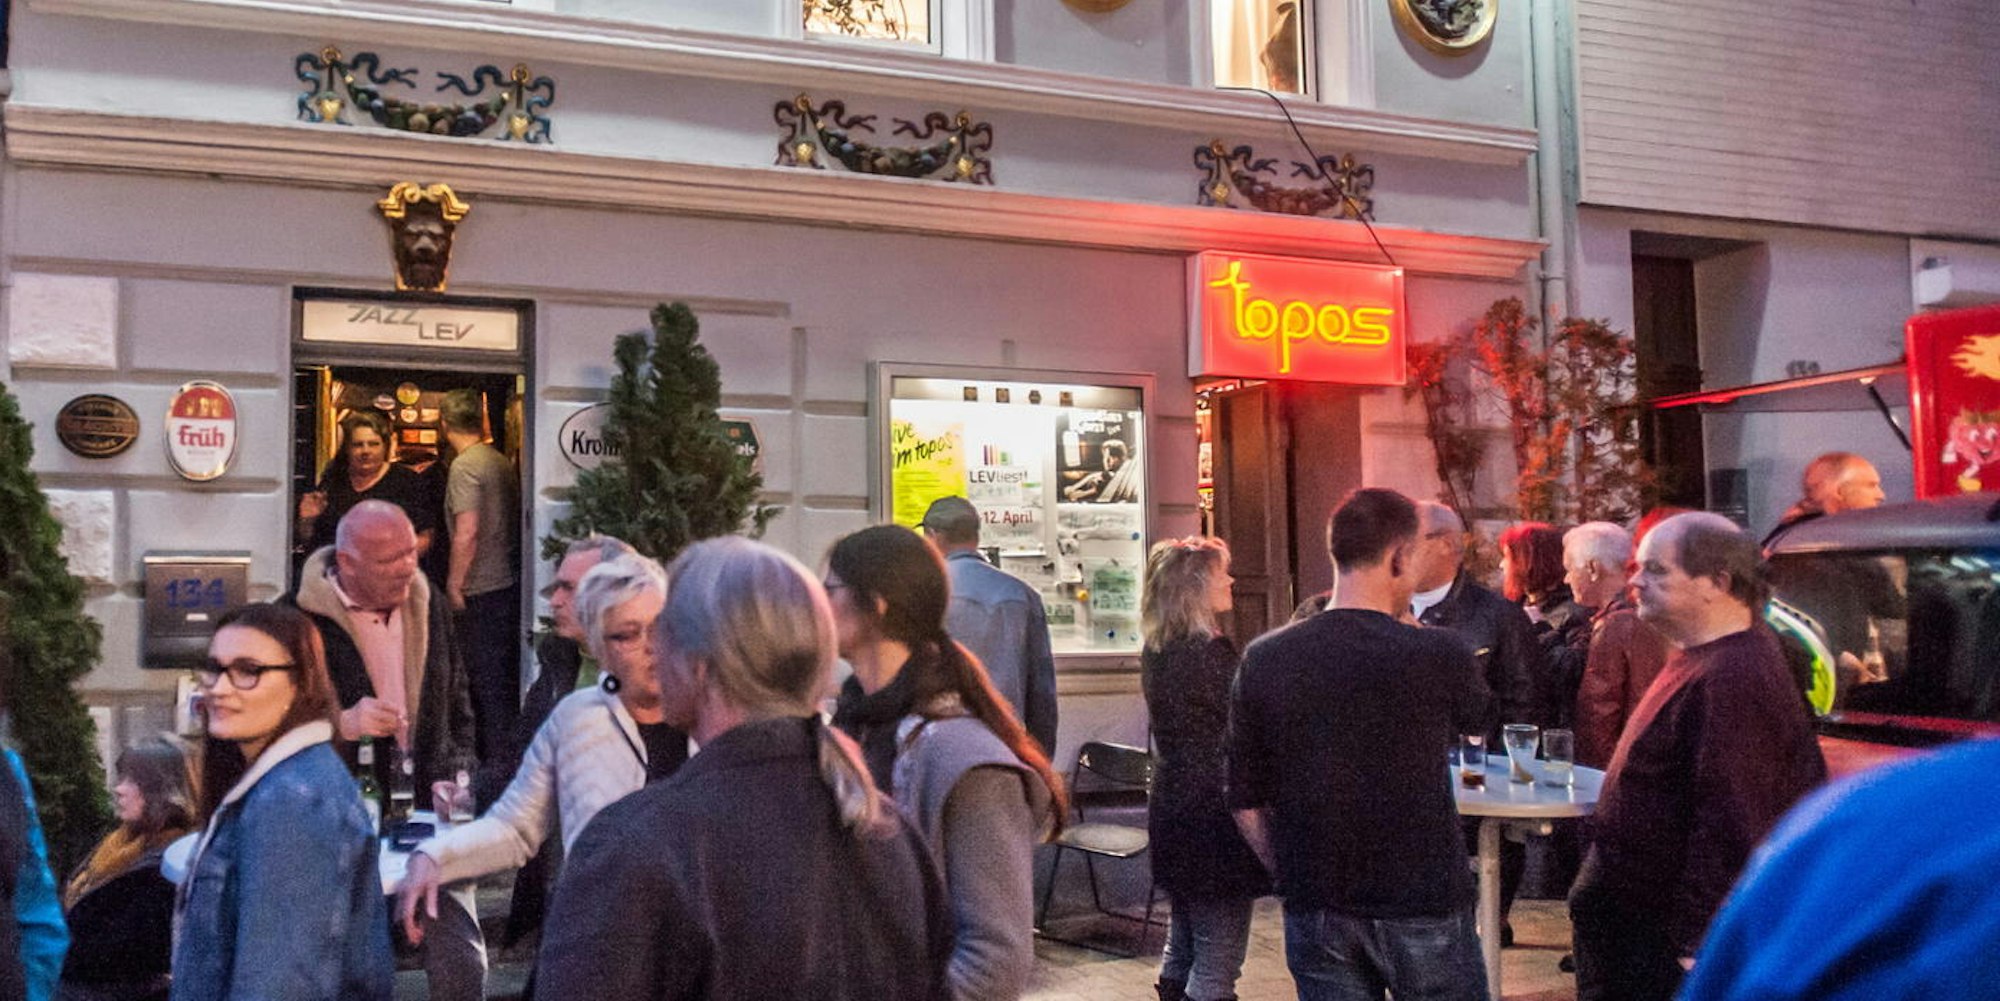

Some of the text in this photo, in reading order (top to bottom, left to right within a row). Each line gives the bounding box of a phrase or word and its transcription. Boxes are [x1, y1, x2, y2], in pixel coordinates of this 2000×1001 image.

[346, 304, 421, 325] JAZZ
[1208, 260, 1394, 375] topos
[418, 322, 475, 342] LEV
[178, 424, 226, 449] früh
[1003, 510, 1034, 528] April
[165, 577, 227, 609] 134
